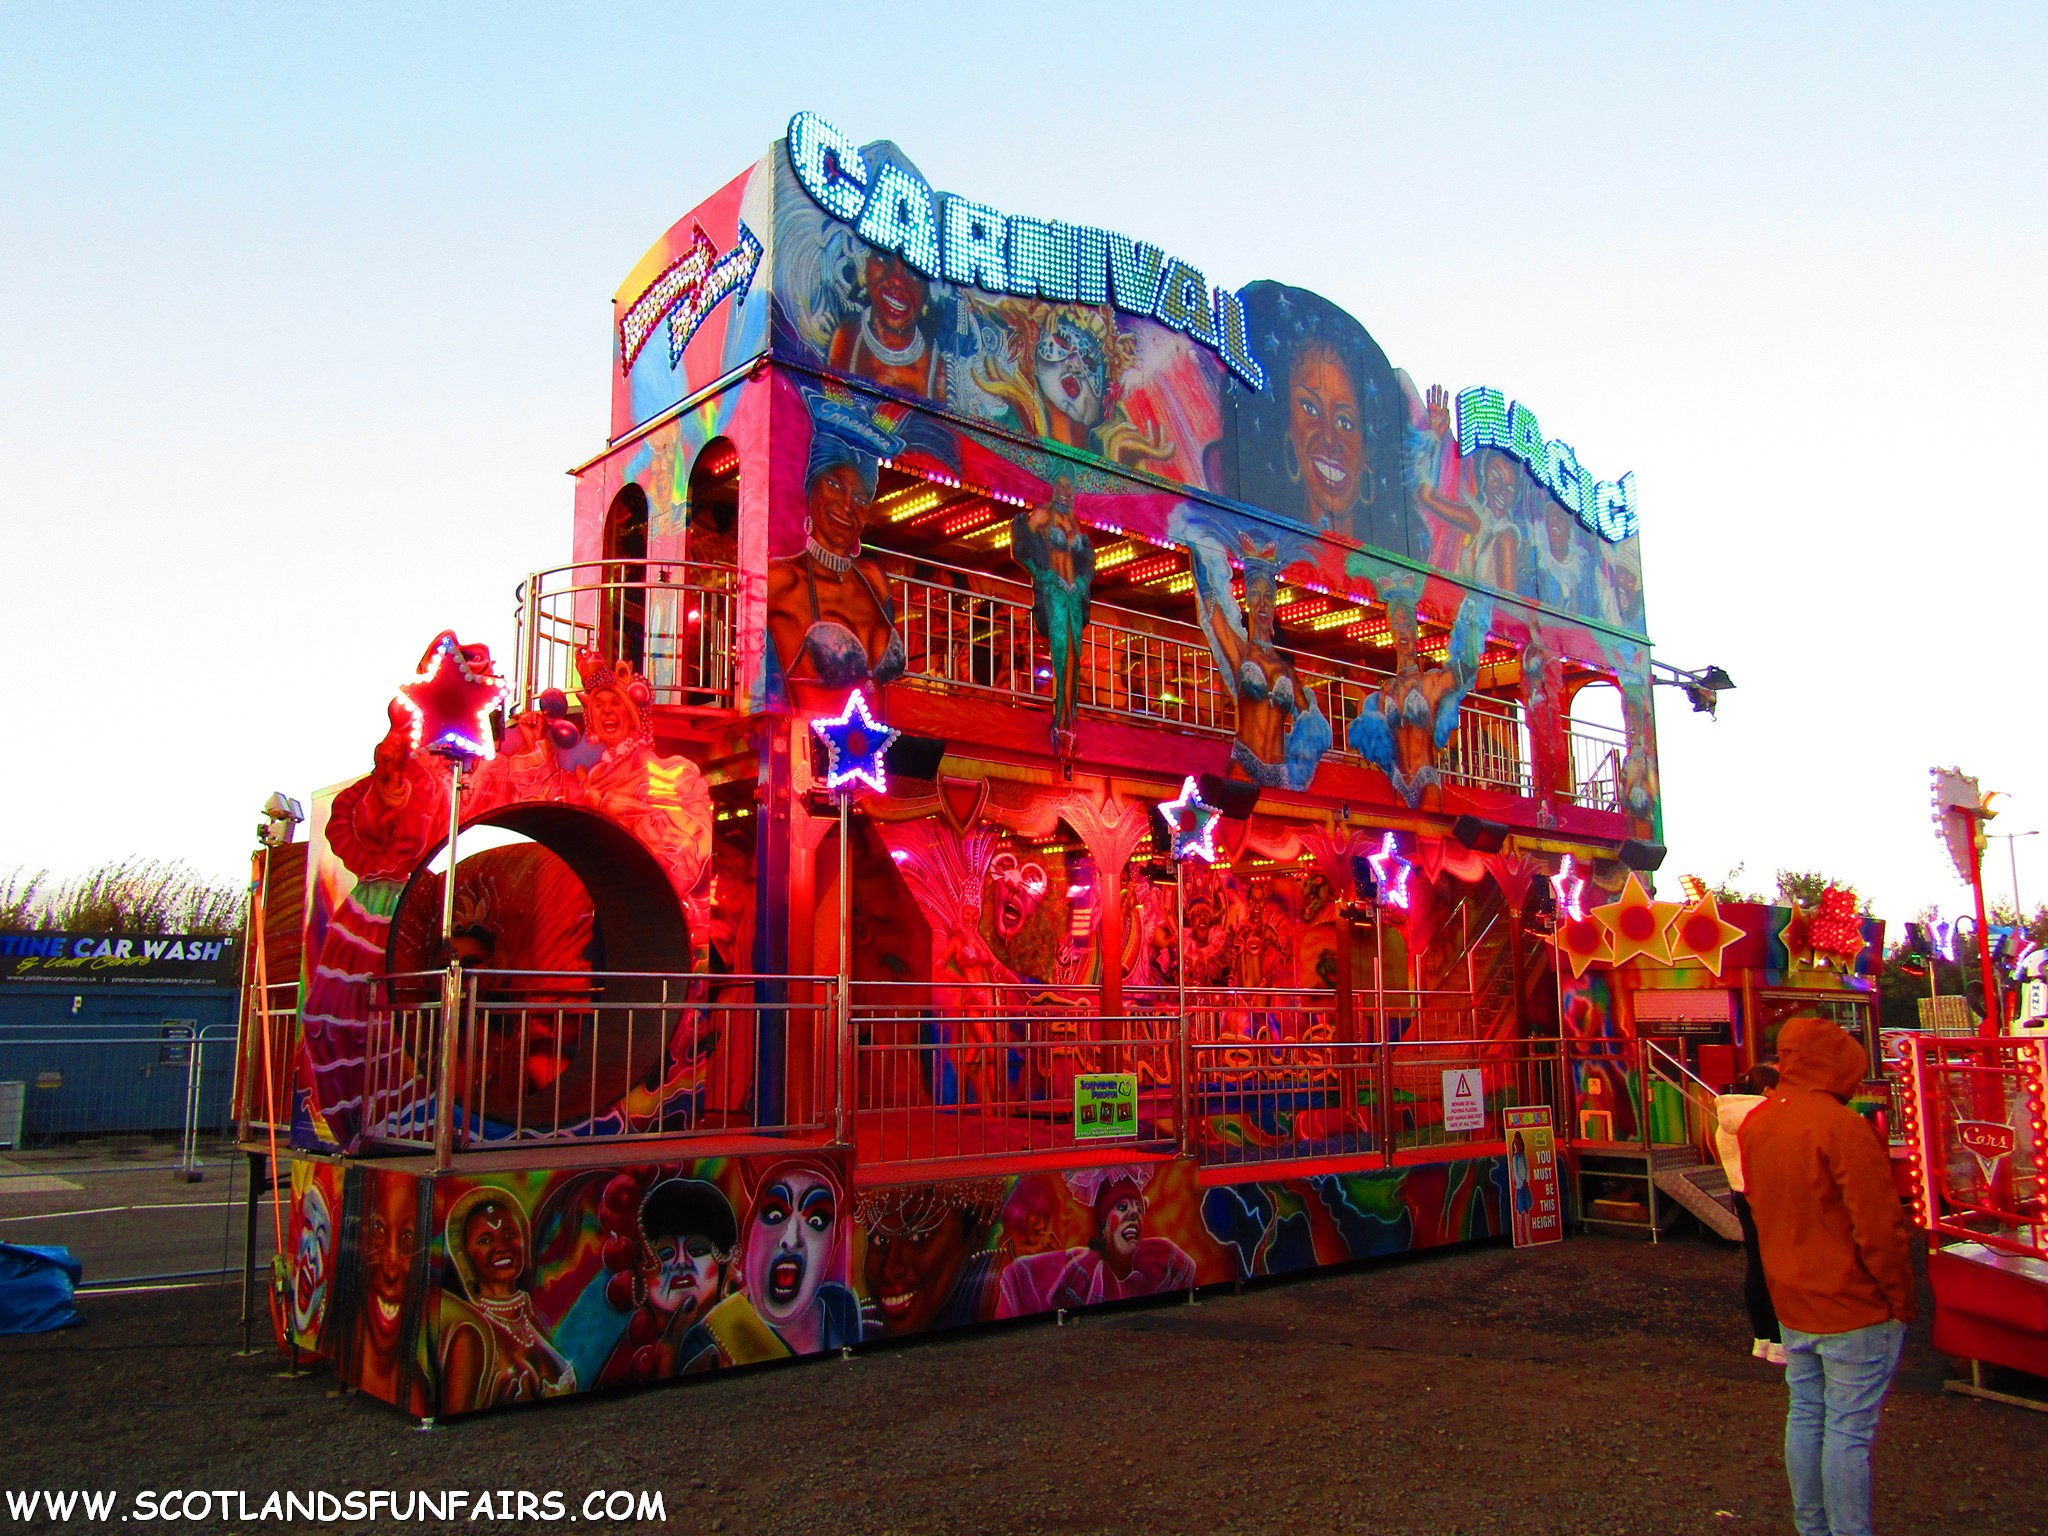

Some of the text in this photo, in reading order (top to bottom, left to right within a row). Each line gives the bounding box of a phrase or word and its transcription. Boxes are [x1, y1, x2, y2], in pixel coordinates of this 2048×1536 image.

[787, 110, 1264, 393] CARNIVAL
[1456, 384, 1639, 544] MAGIC
[73, 937, 133, 958] CAR
[144, 940, 223, 960] WASH
[1963, 1126, 2009, 1149] Cars
[1536, 1150, 1552, 1164] YOU
[1533, 1167, 1553, 1180] MUST
[1545, 1183, 1554, 1196] BE
[1540, 1198, 1556, 1213] THIS
[1532, 1215, 1556, 1230] HEIGHT
